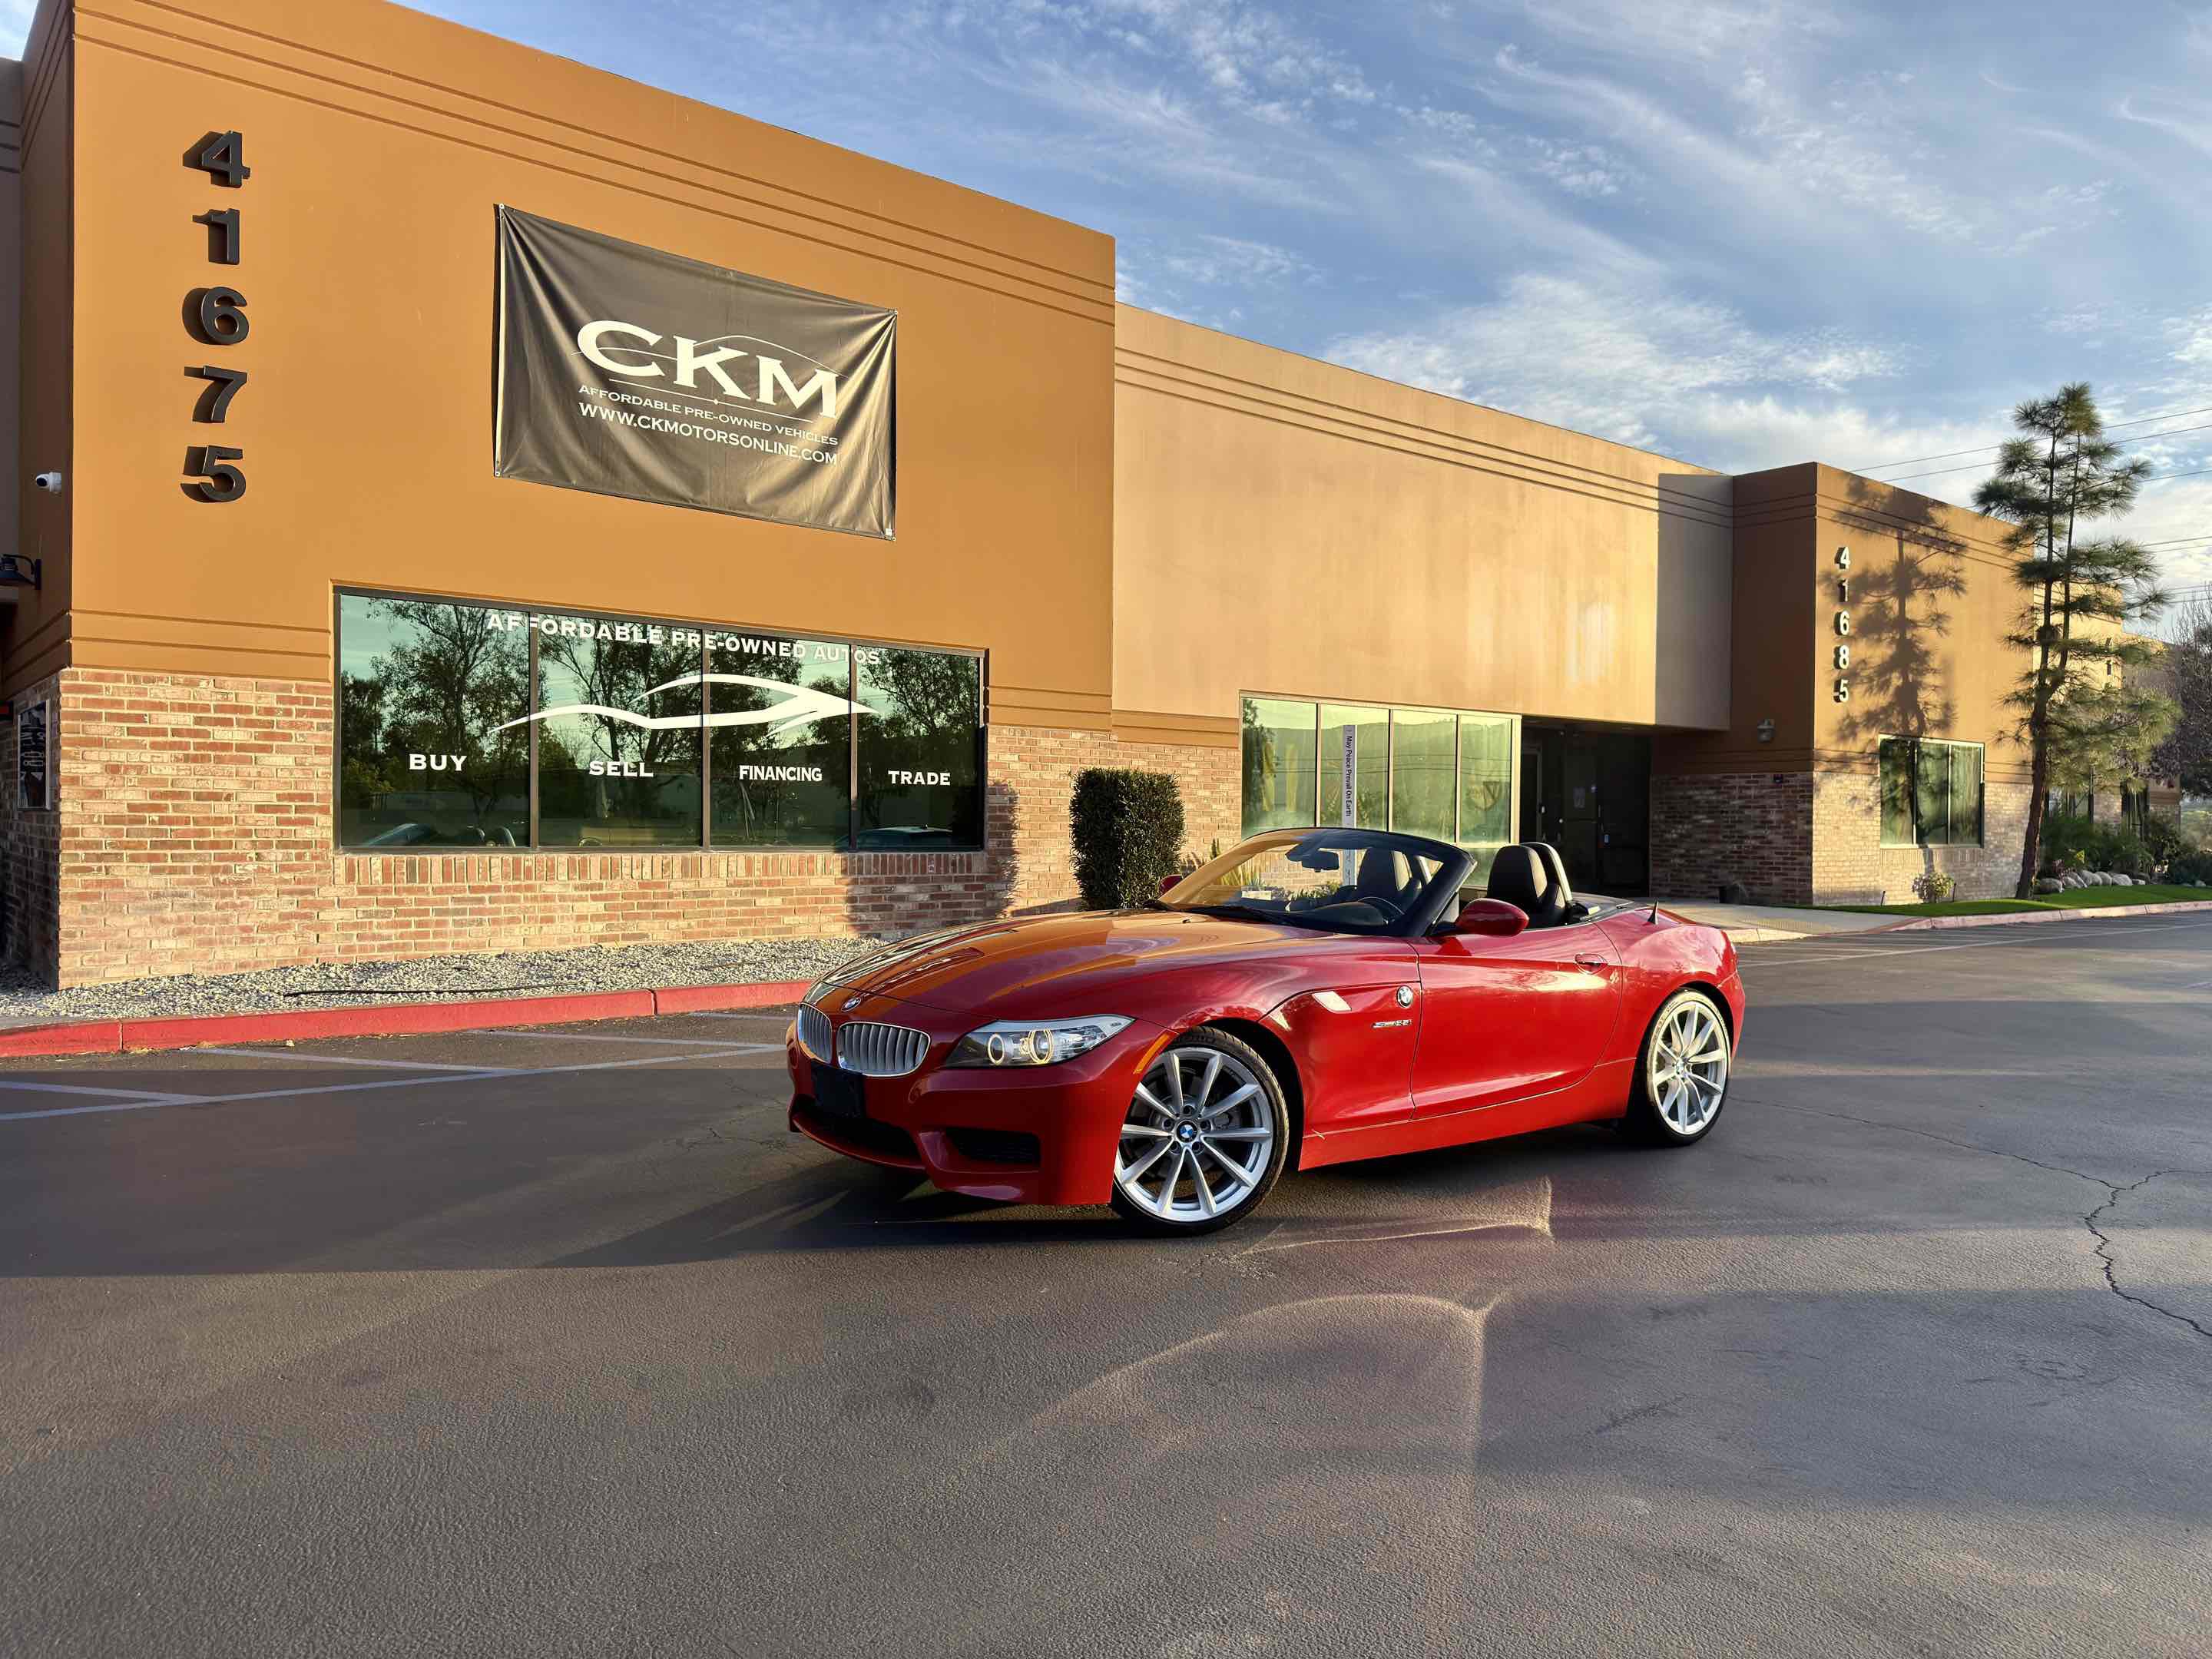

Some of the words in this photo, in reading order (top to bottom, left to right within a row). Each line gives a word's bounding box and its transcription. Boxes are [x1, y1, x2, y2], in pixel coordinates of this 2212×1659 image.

[183, 130, 250, 503] 41675
[577, 320, 839, 419] CKM
[578, 385, 682, 413] AFFORDABLE
[684, 406, 772, 432] PRE-OWNED
[775, 425, 839, 445] VEHICLES
[578, 402, 837, 465] WWW.CKMOTORSONLINE.COM
[1834, 546, 1851, 704] 41685
[672, 631, 806, 658] PRE-OWNED
[813, 645, 881, 664] AUTOS
[409, 753, 468, 772] BUY
[588, 761, 654, 777] SELL
[739, 765, 823, 782] FINANCING
[888, 770, 951, 786] TRADE
[1346, 790, 1352, 800] On
